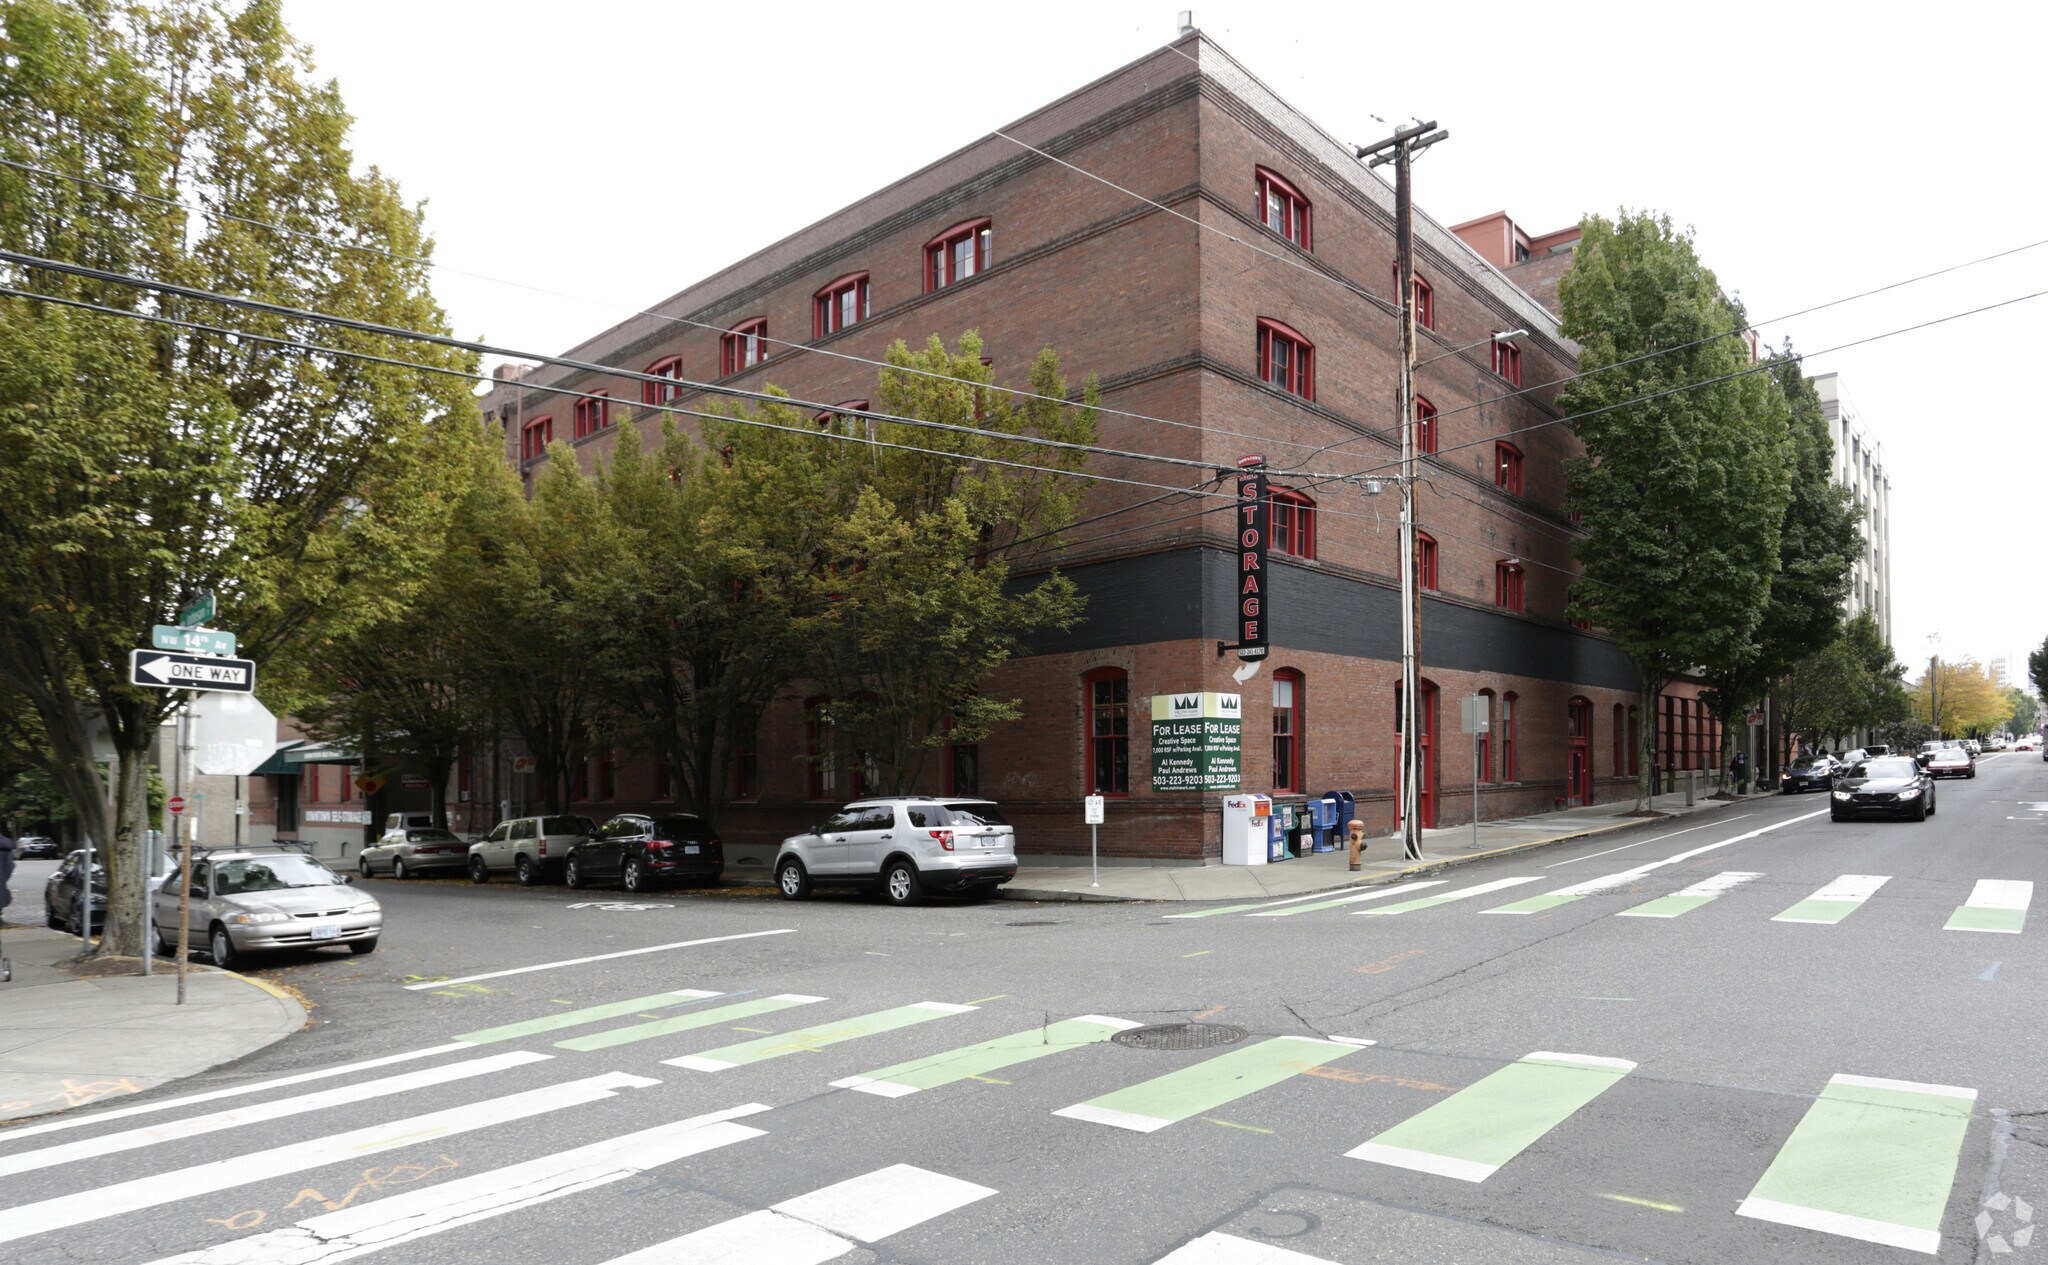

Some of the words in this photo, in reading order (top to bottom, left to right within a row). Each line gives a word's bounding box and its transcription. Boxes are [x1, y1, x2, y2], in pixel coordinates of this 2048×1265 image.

[1242, 483, 1260, 640] STORAGE
[160, 635, 178, 645] NW
[184, 634, 210, 647] 14th
[214, 640, 227, 650] Av
[172, 664, 203, 678] ONE
[210, 668, 241, 682] WAY
[1158, 737, 1180, 745] Creative
[1180, 736, 1196, 745] Space
[1226, 736, 1236, 744] Space
[1169, 758, 1193, 766] Kennedy
[1217, 757, 1234, 765] Kennedy
[1153, 776, 1203, 785] 503-223-9203
[1204, 774, 1240, 784] 503-223-9203
